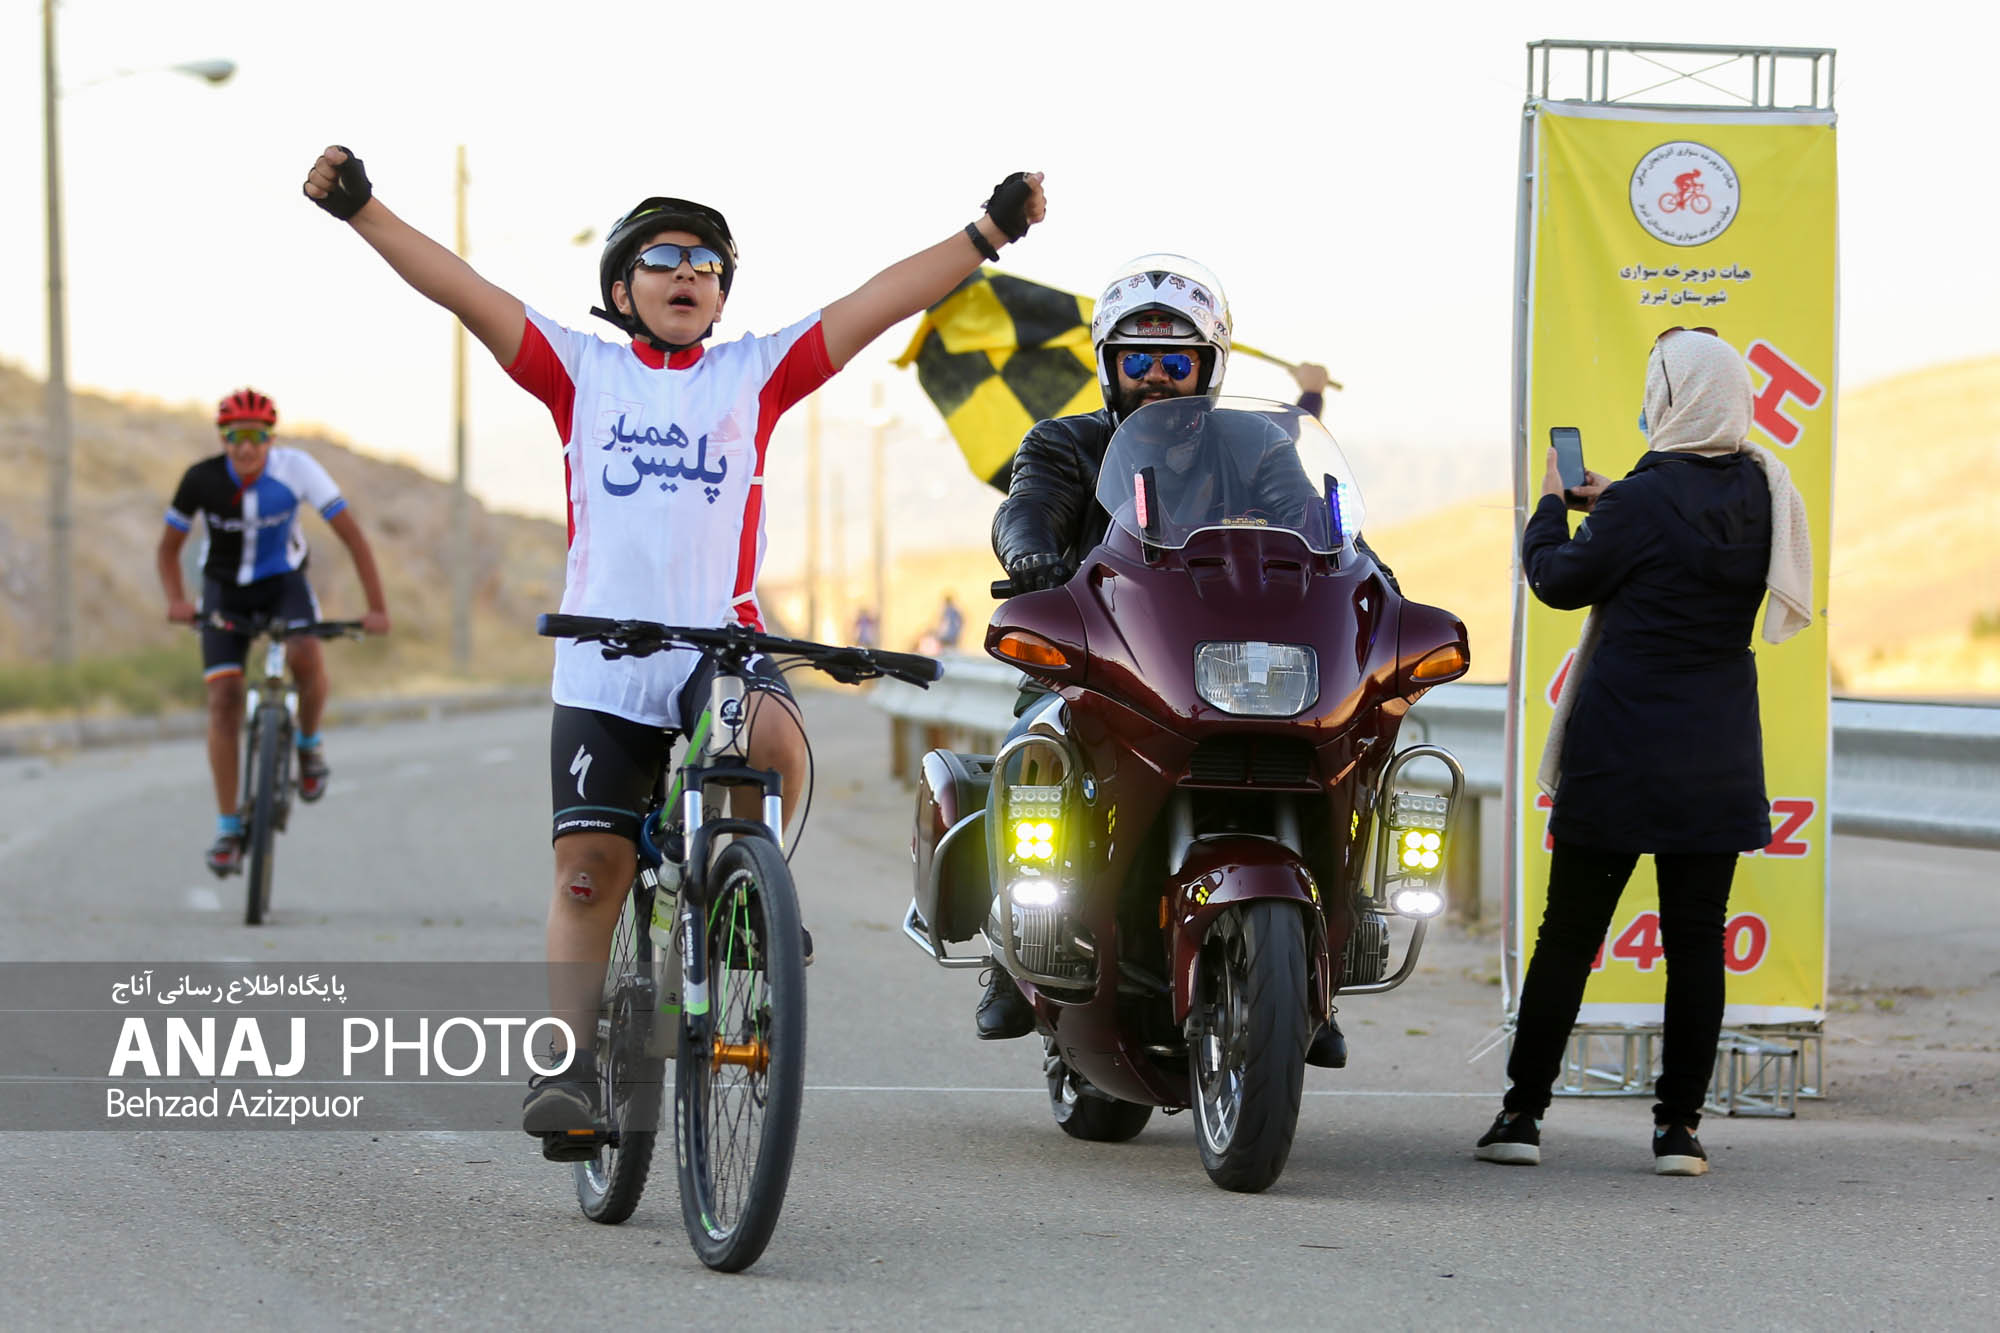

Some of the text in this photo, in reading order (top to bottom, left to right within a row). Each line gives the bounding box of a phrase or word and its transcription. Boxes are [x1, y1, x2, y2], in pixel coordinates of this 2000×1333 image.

[1620, 264, 1659, 281] سواری
[1663, 264, 1716, 282] دوچرخه
[1640, 289, 1726, 307] شهرستان تبریز
[602, 413, 689, 453] همیار
[602, 434, 728, 504] پلیس
